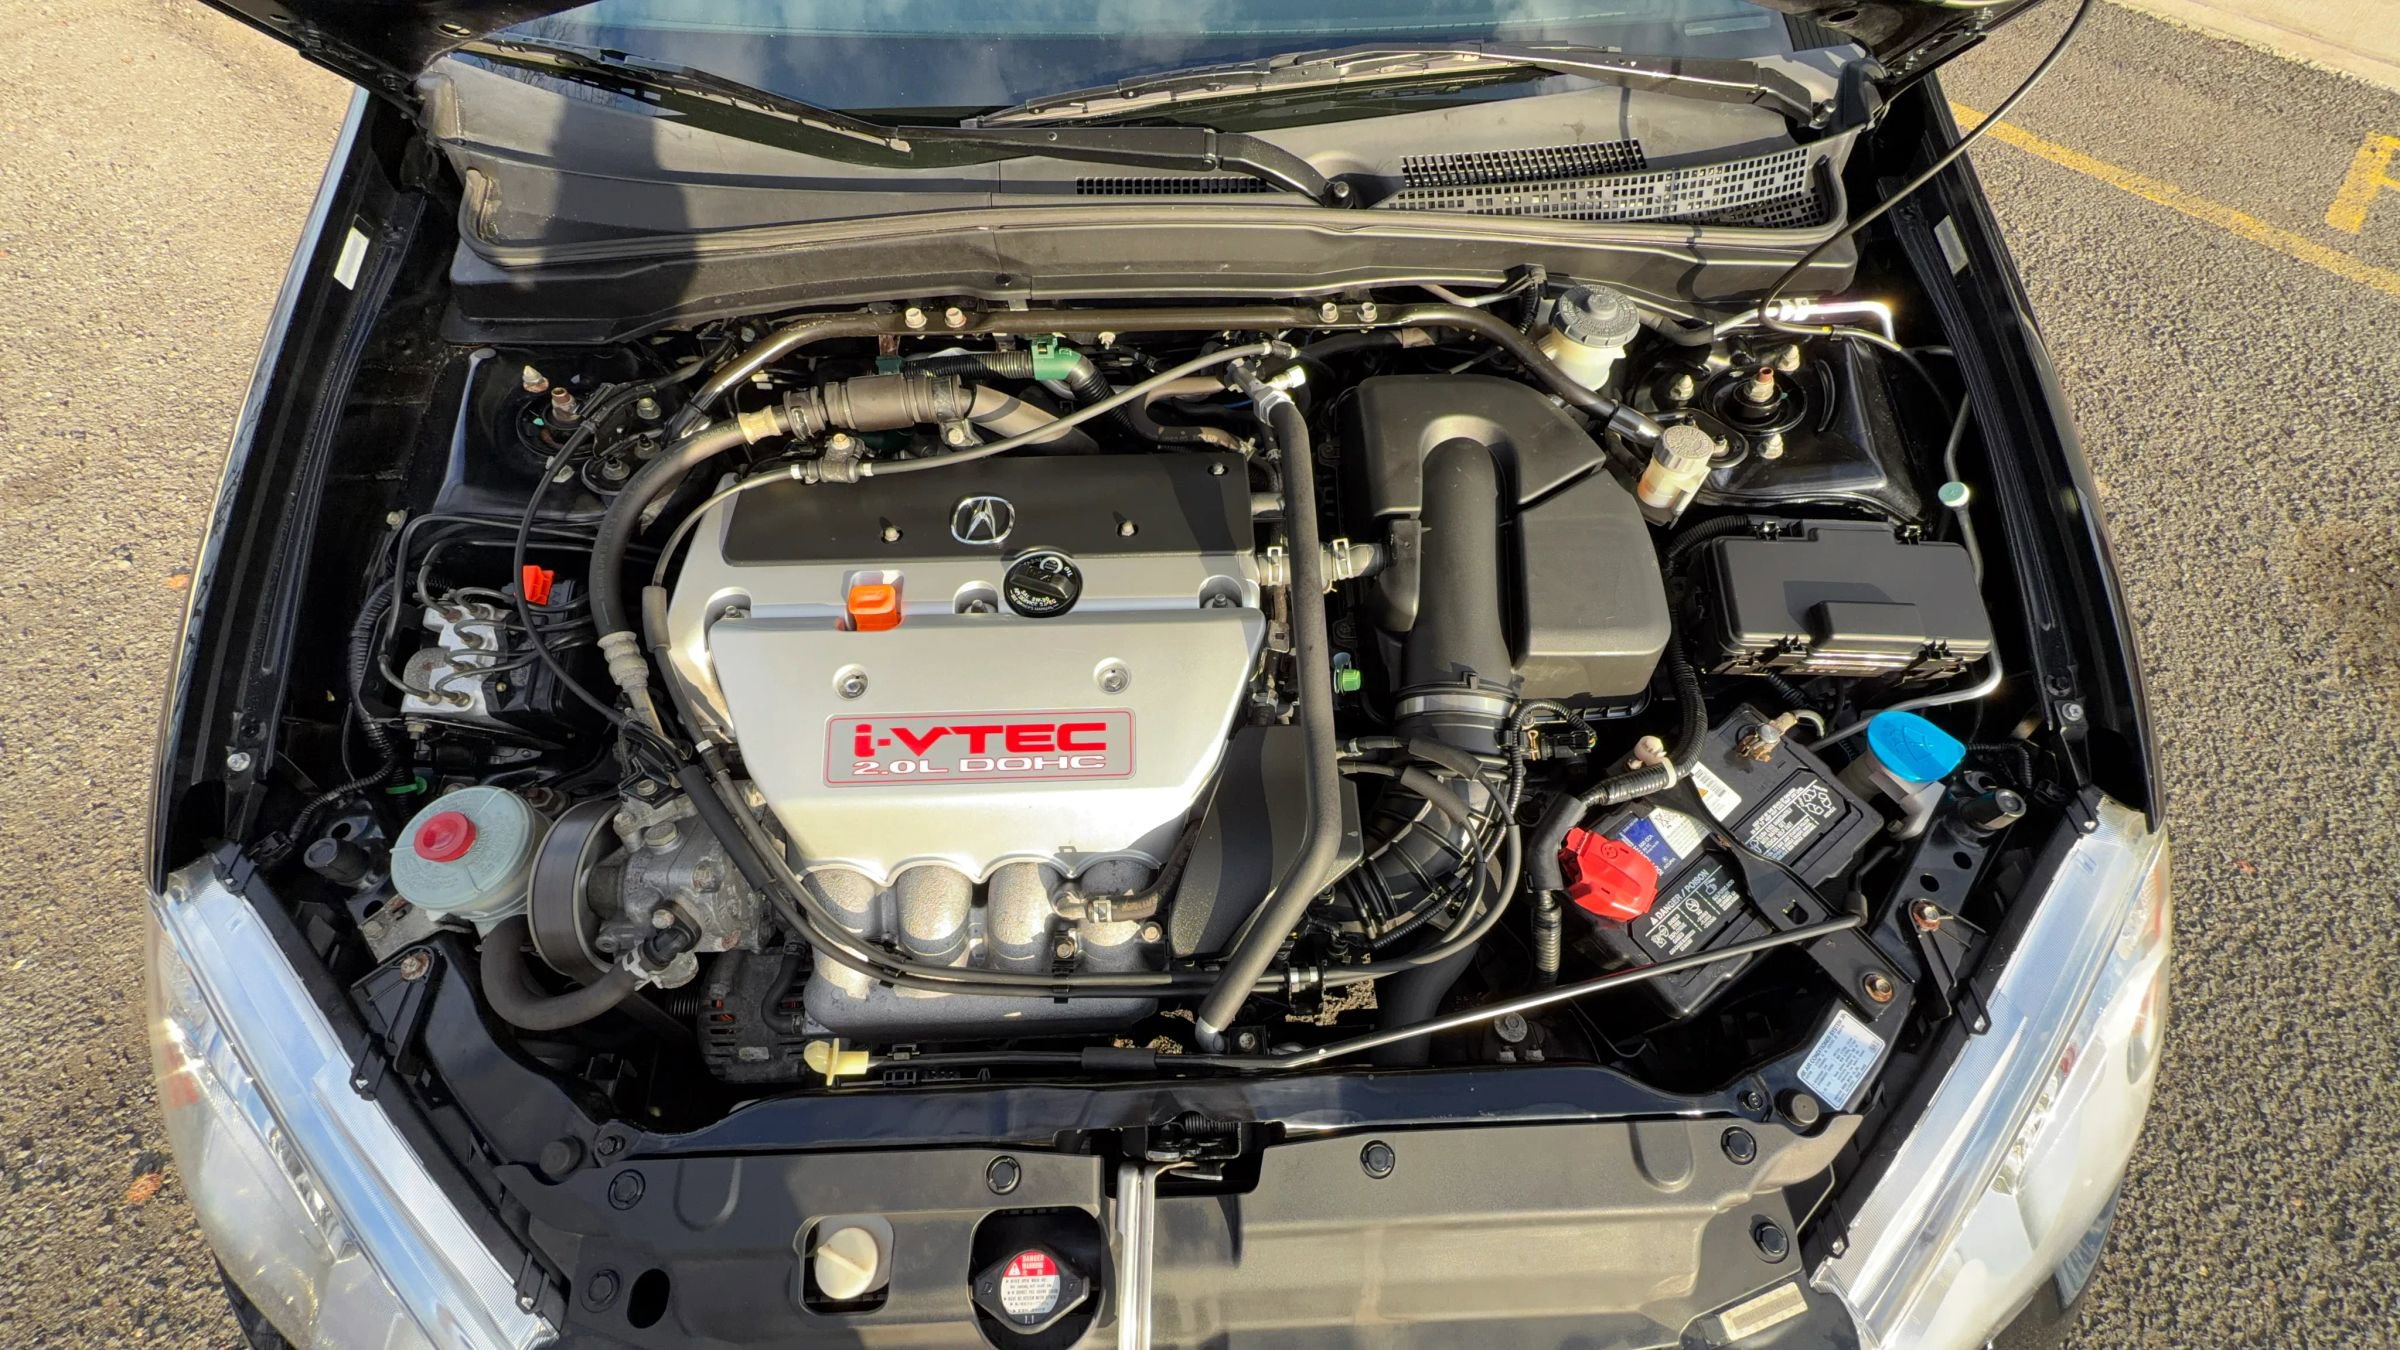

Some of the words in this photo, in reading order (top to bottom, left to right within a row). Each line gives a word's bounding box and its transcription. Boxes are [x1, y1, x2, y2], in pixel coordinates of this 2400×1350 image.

[853, 722, 1107, 757] i-VTEC
[852, 760, 949, 775] 2.0L
[958, 755, 1106, 772] DOHC
[1655, 892, 1683, 920] DANGER
[1684, 868, 1709, 892] POISON
